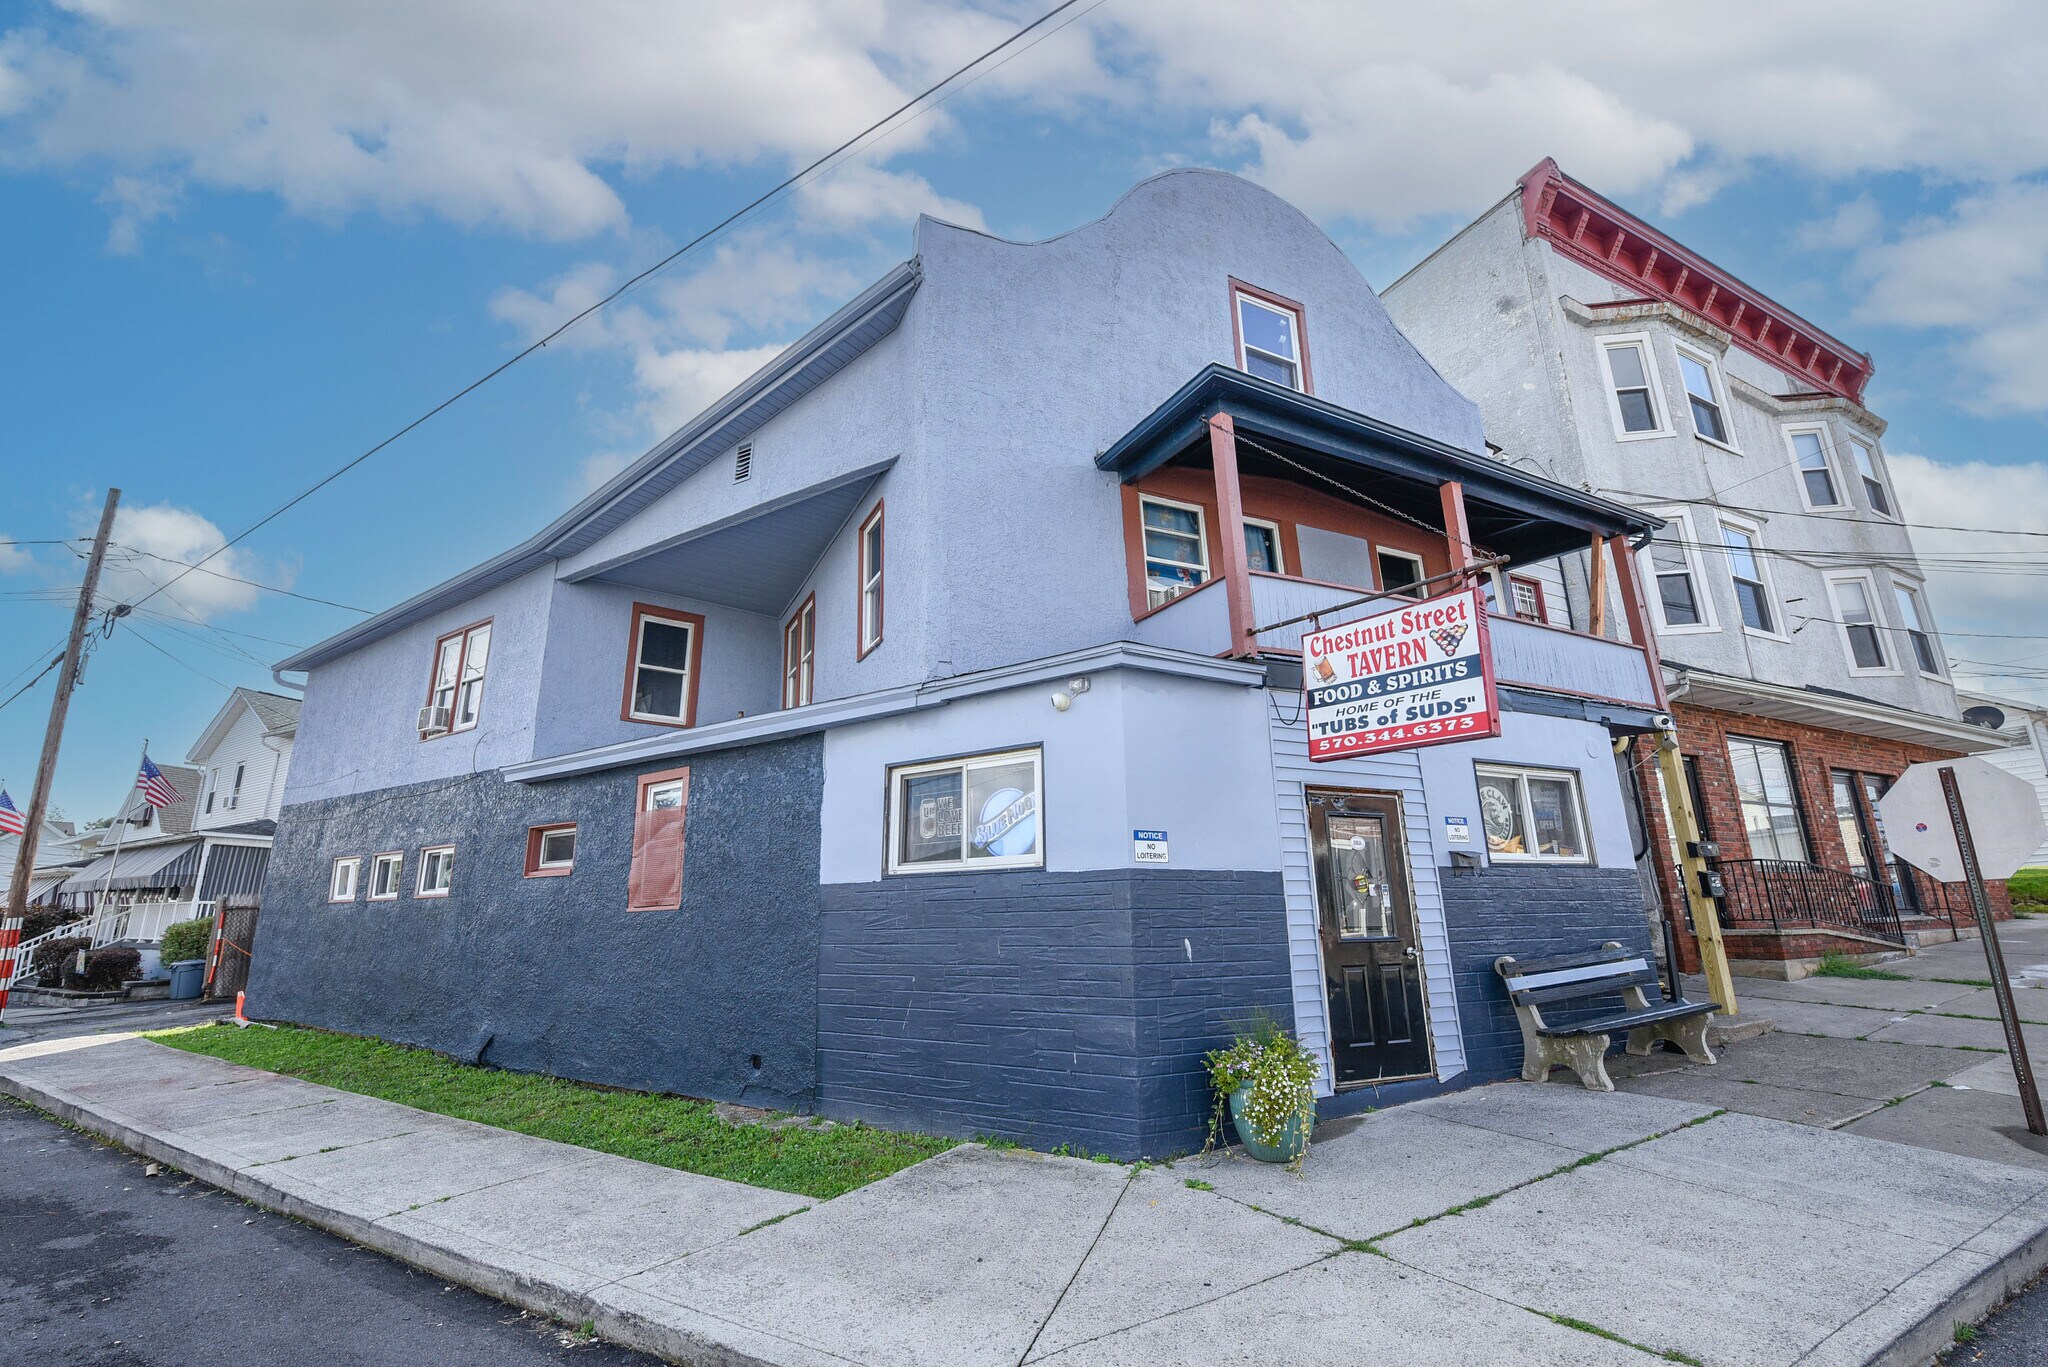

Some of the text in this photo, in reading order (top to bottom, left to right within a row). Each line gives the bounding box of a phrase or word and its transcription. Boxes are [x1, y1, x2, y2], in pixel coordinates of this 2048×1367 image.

[1310, 599, 1468, 658] Chestnut Street
[1347, 636, 1428, 678] TAVERN
[1313, 660, 1468, 706] FOOD & SPIRITS
[1312, 695, 1476, 736] "TUBS of SUDS"
[1335, 689, 1442, 717] HOME OF THE
[1319, 716, 1475, 751] 570.344.6373
[936, 796, 954, 810] WE
[1487, 789, 1508, 809] CLAW
[1138, 832, 1163, 840] NOTICE
